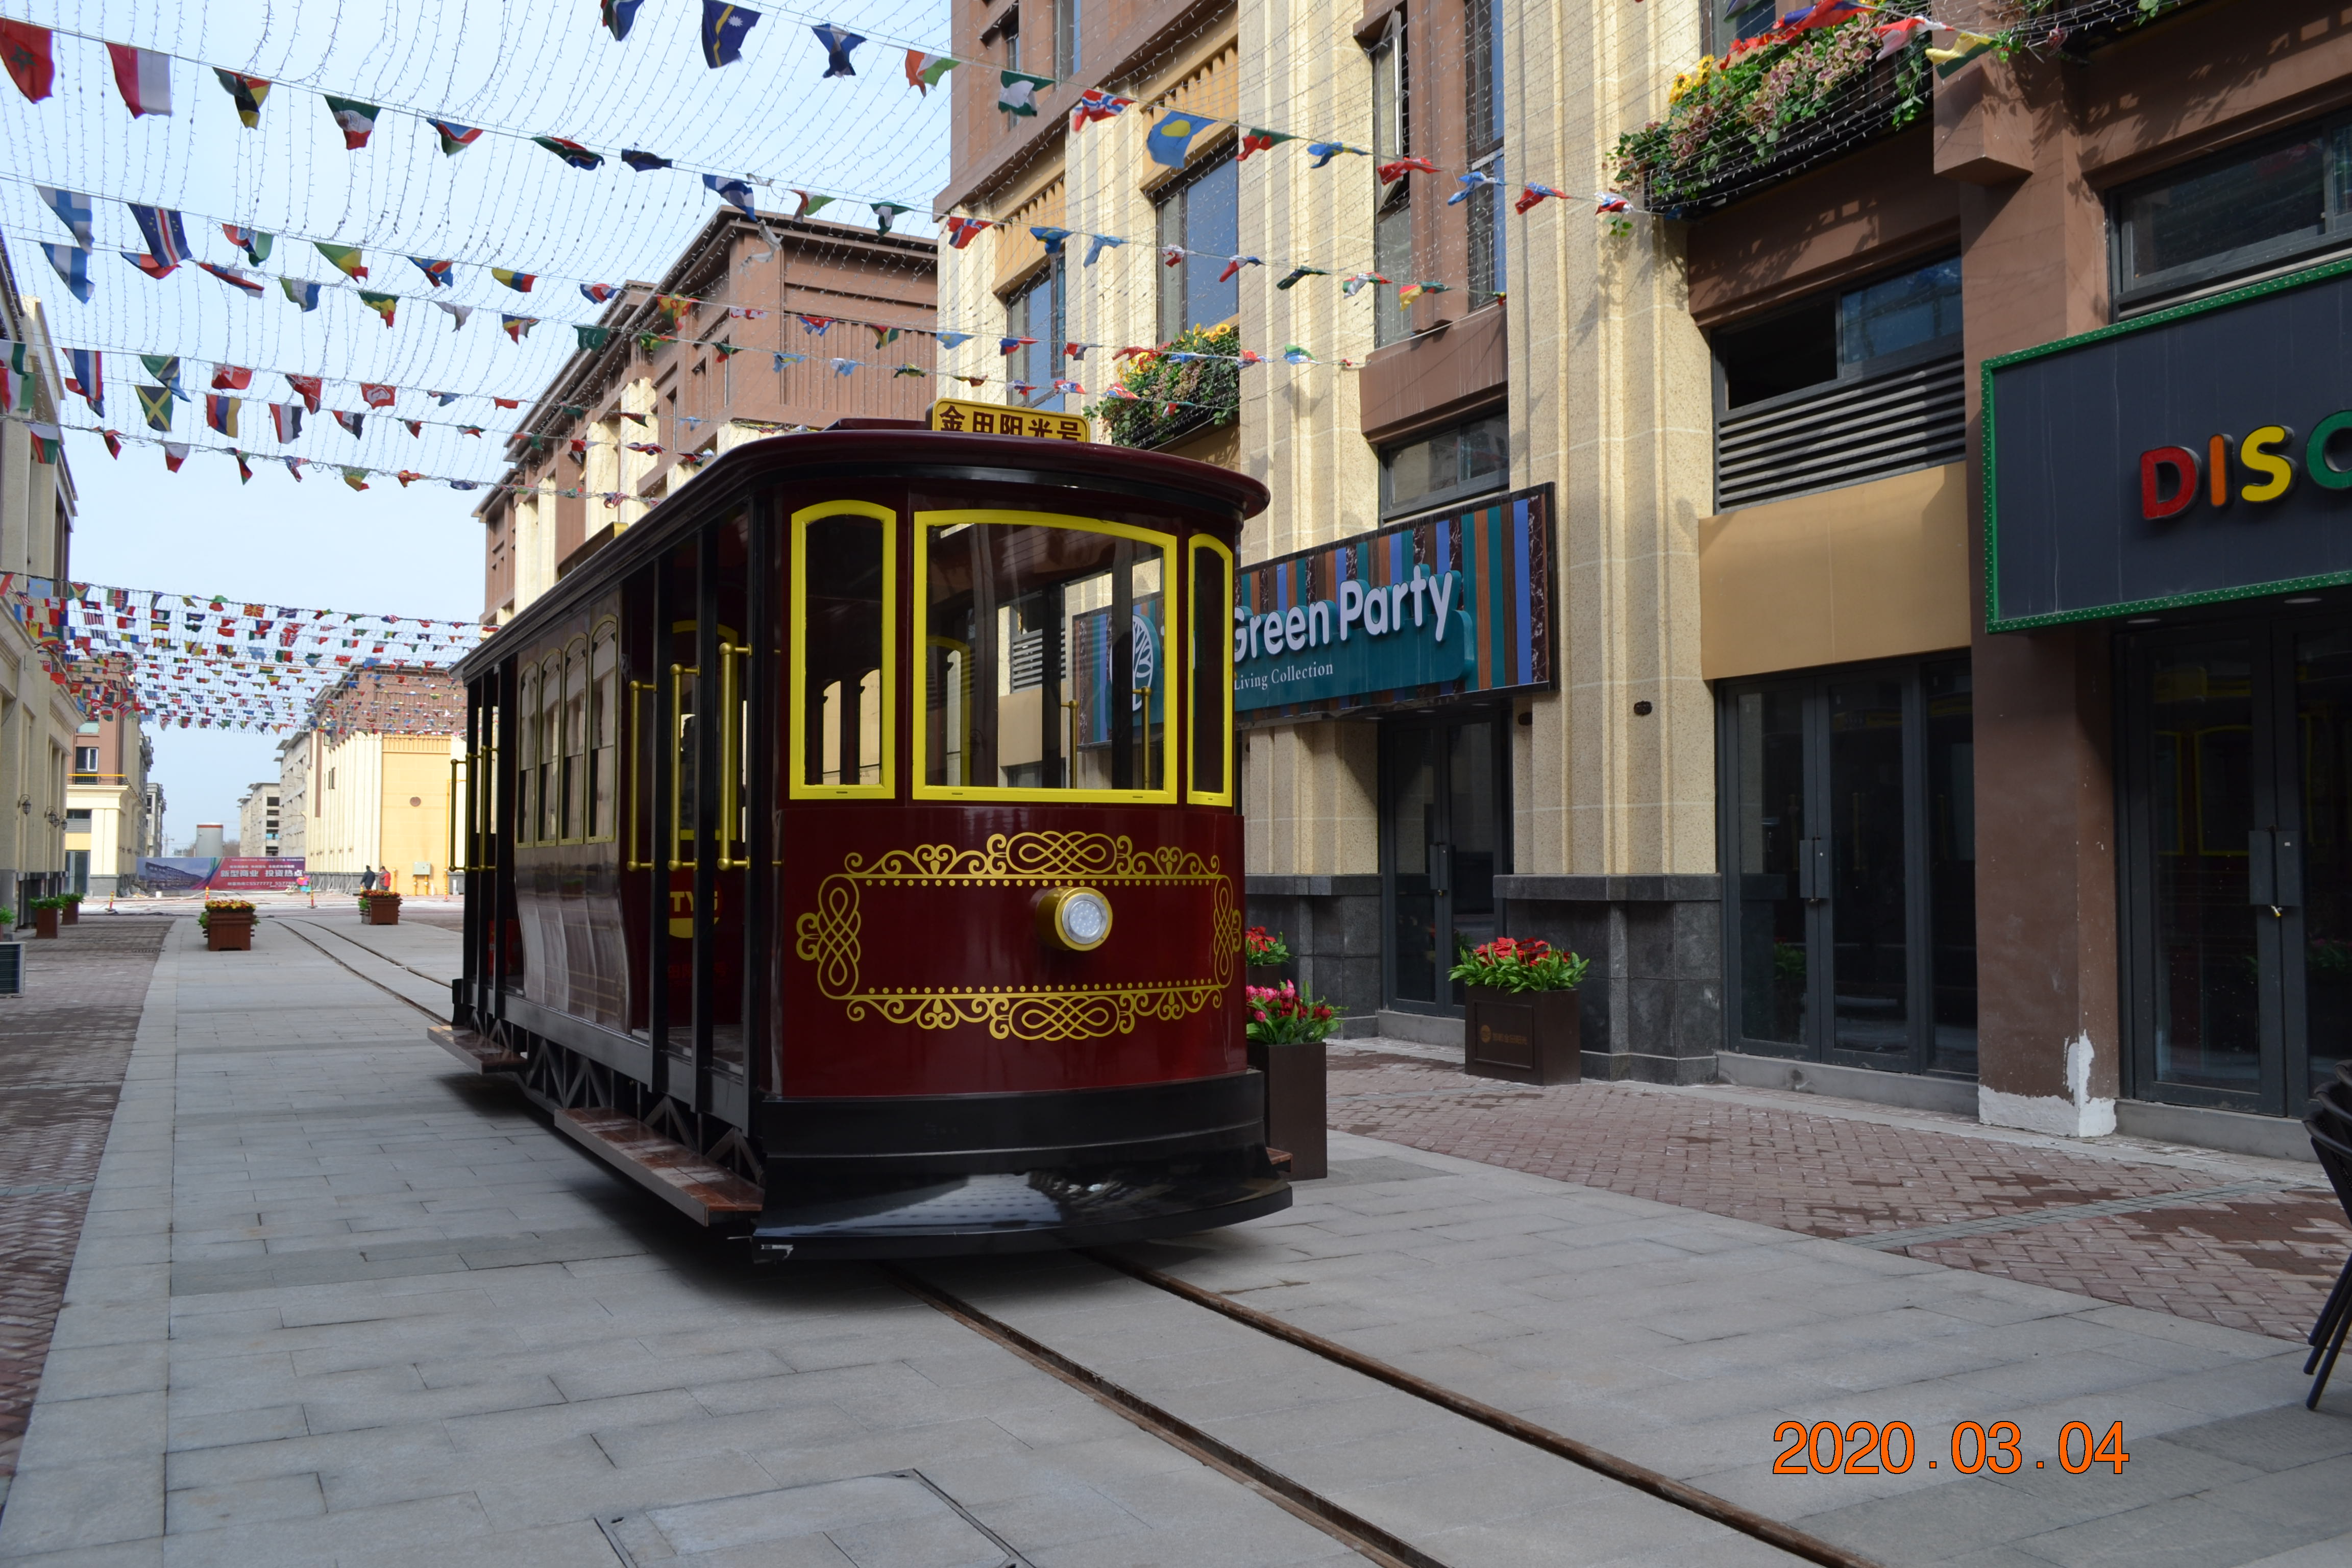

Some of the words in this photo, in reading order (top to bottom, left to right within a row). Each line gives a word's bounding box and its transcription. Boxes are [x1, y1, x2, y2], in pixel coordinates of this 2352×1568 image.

[939, 405, 1081, 442] 金田阳光号
[1235, 601, 1329, 663] Green
[1340, 565, 1453, 642] Party
[1234, 673, 1267, 690] Living
[1271, 662, 1334, 683] Collection
